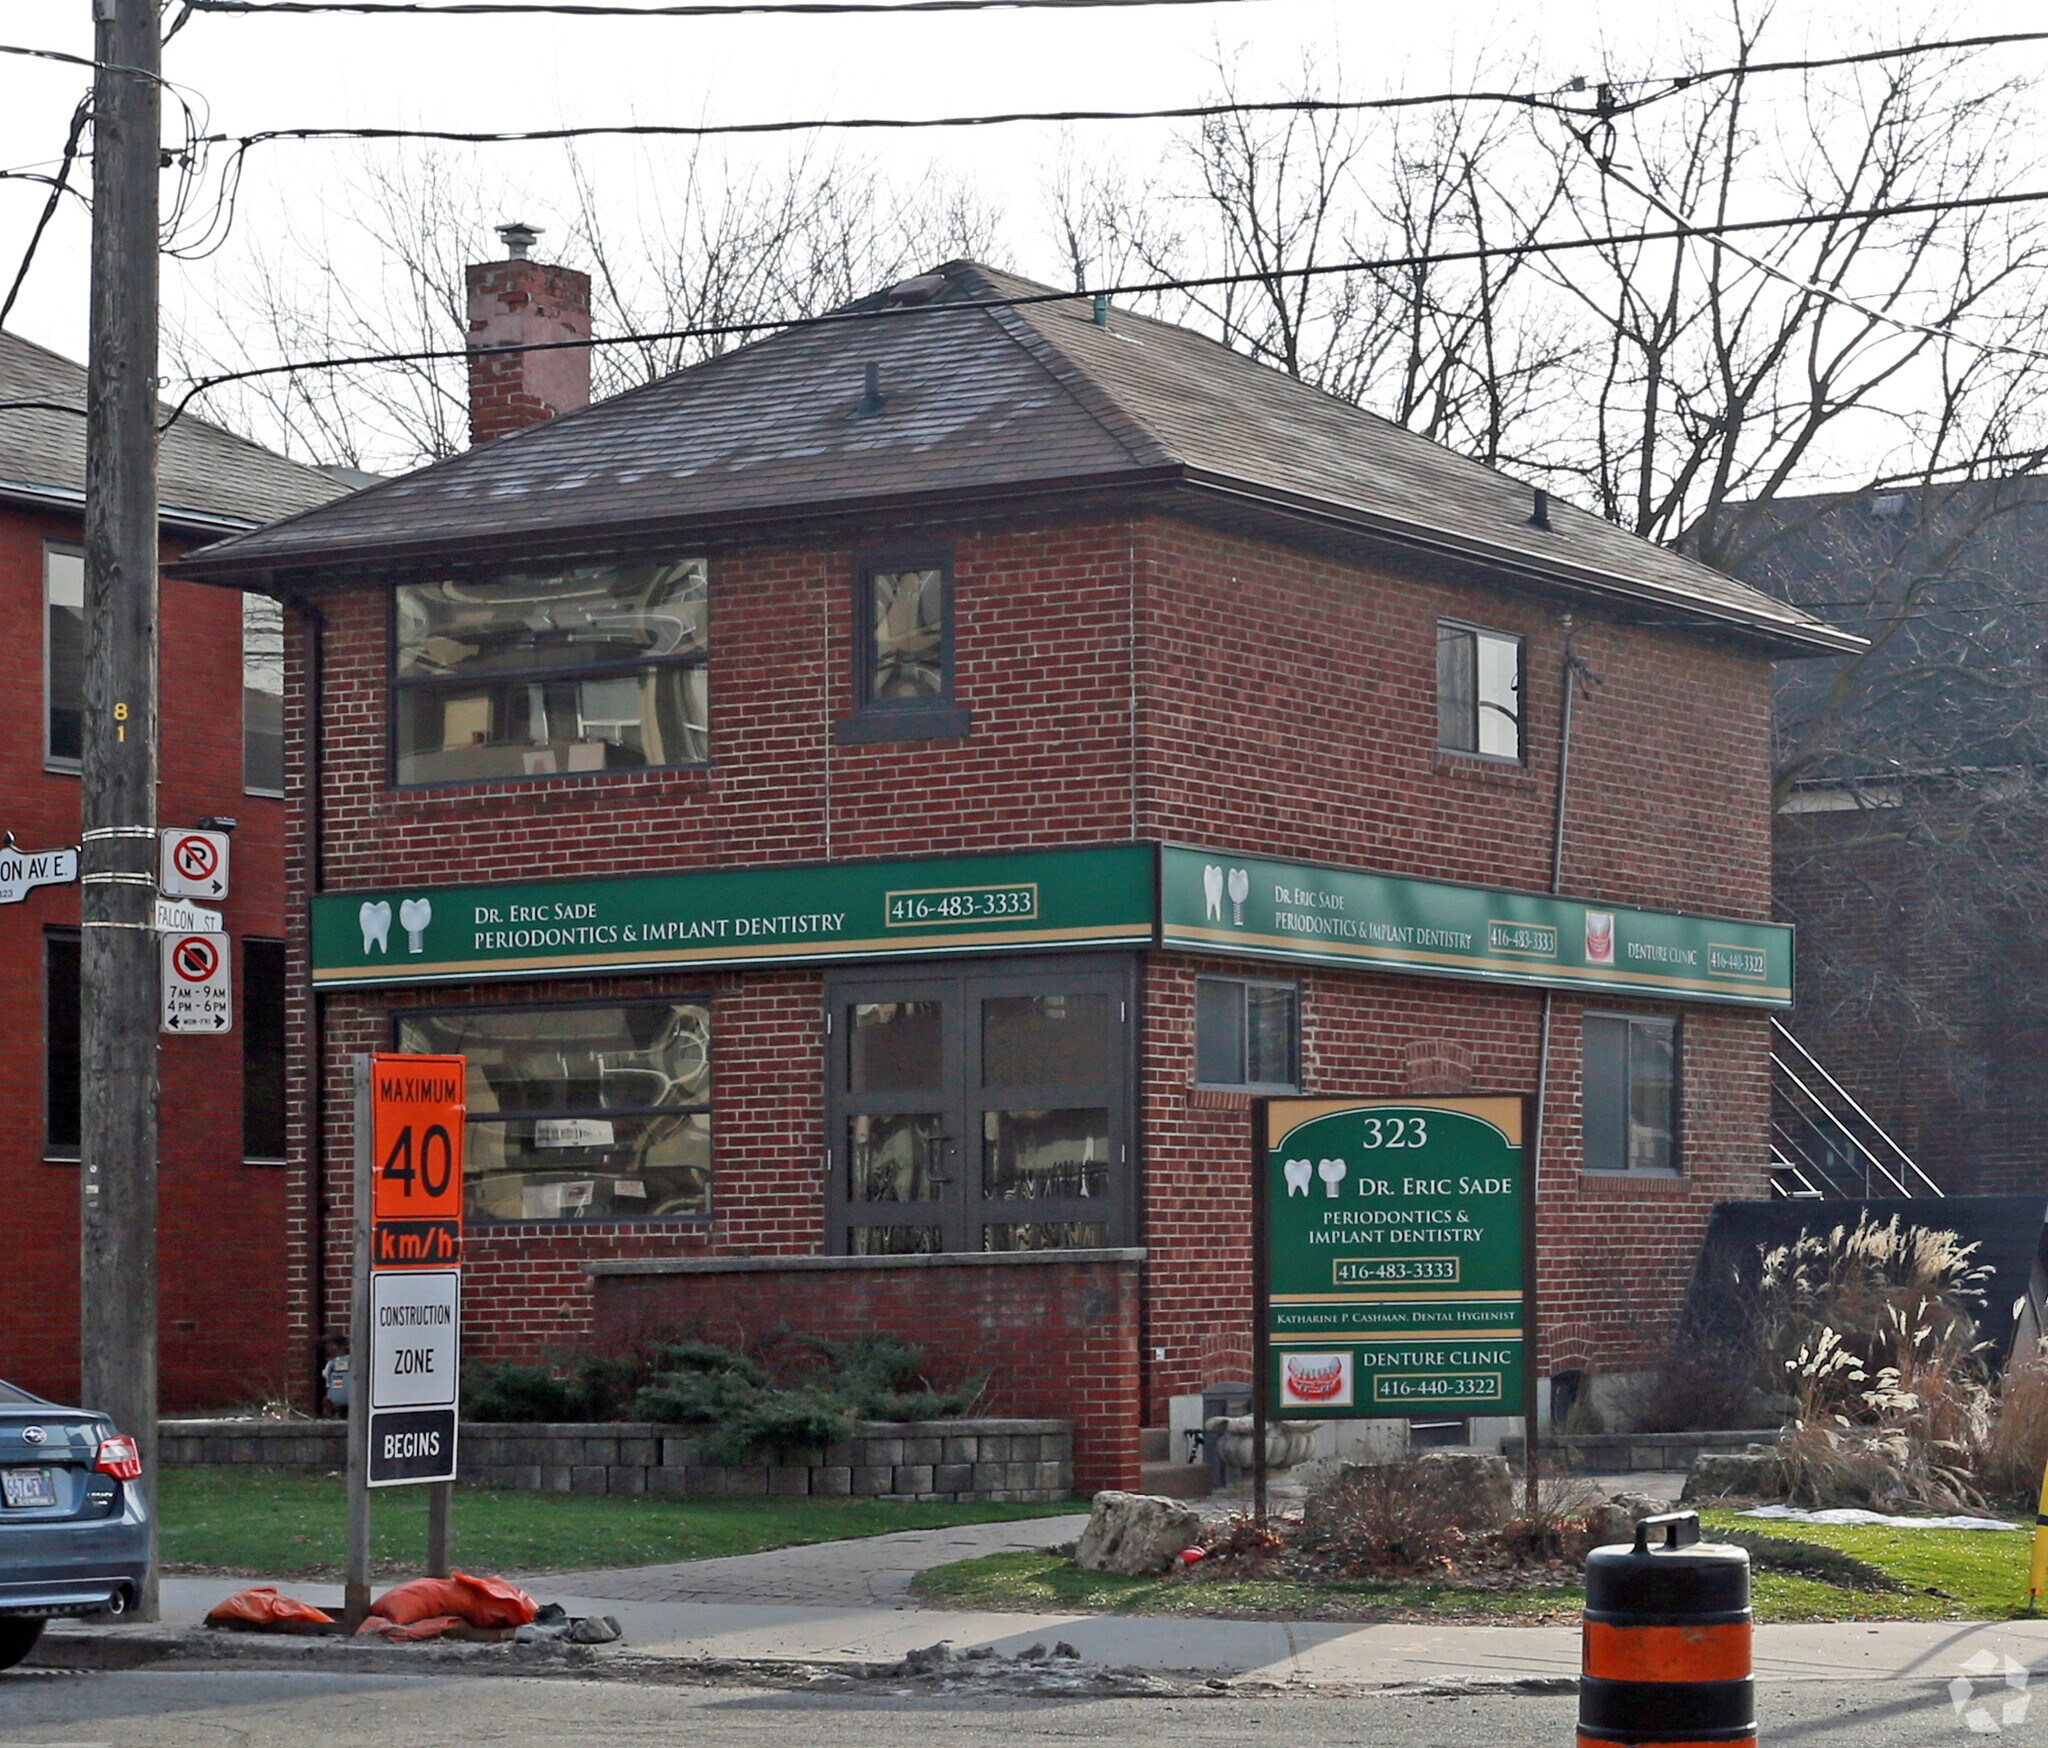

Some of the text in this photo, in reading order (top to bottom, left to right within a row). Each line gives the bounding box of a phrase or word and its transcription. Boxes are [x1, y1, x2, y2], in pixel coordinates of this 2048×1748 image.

[28, 857, 48, 879] AV.
[54, 855, 67, 876] E.
[892, 892, 1031, 919] 416-483-3333
[158, 906, 195, 931] FALCON
[474, 913, 845, 949] PERIODONTICS & IMPLANT DENTISTRY
[1275, 911, 1472, 949] PERIODONTICS & IMPLANT DENTISTRY
[1491, 928, 1553, 951] 416-483-3333
[1628, 942, 1697, 965] DENTURE CLINIC
[381, 1078, 456, 1103] MAXIMUM
[1363, 1117, 1428, 1149] 323
[382, 1124, 452, 1197] 40
[1323, 1210, 1469, 1225] PERIODONTICS &
[381, 1227, 453, 1259] km/h
[1309, 1228, 1484, 1244] IMPLANT DENTISTRY
[1338, 1263, 1454, 1279] 416-483-3333
[380, 1305, 451, 1327] CONSTRUCTION
[394, 1349, 434, 1374] ZONE
[1363, 1351, 1512, 1367] DENTURE CLINIC
[1380, 1379, 1495, 1396] 416-440-3322
[384, 1431, 440, 1459] BEGINS
